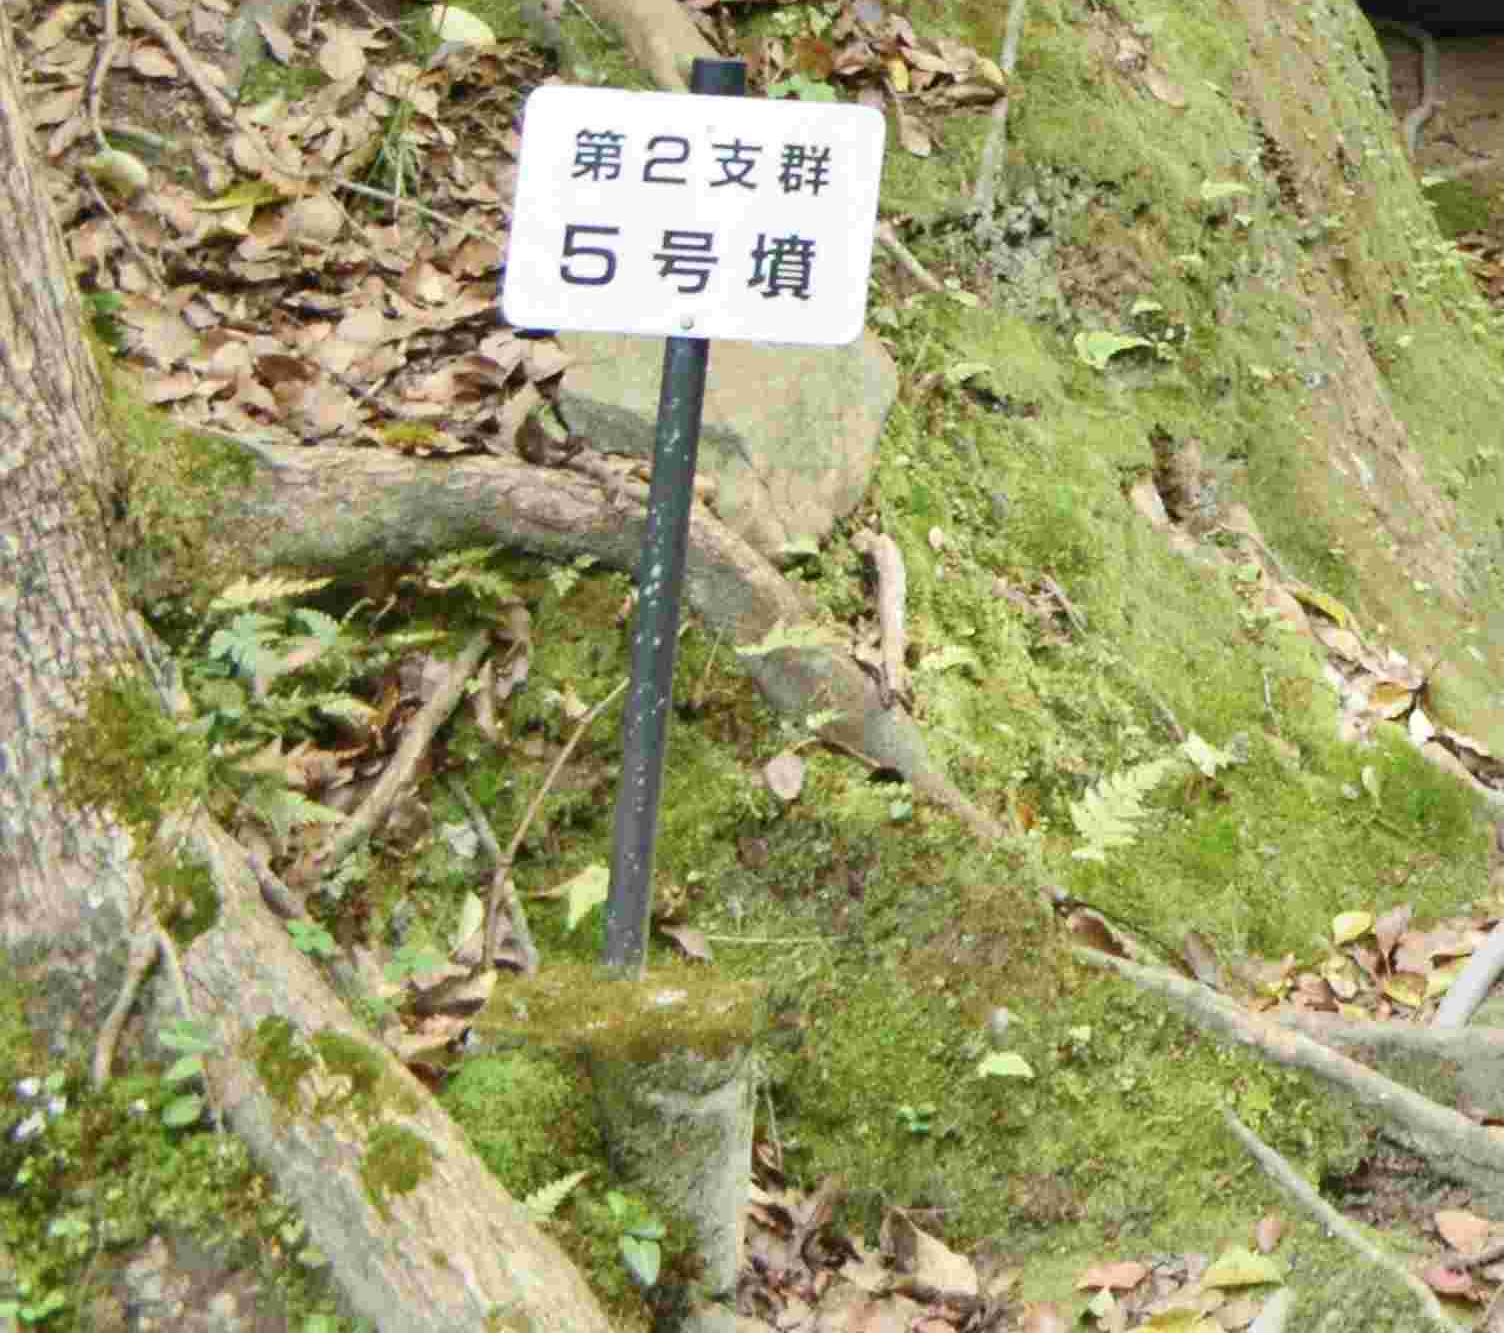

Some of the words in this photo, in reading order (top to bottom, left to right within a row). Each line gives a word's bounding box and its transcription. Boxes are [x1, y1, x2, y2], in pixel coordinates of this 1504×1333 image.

[571, 129, 831, 195] 第2支群
[560, 223, 817, 301] 5号墳
